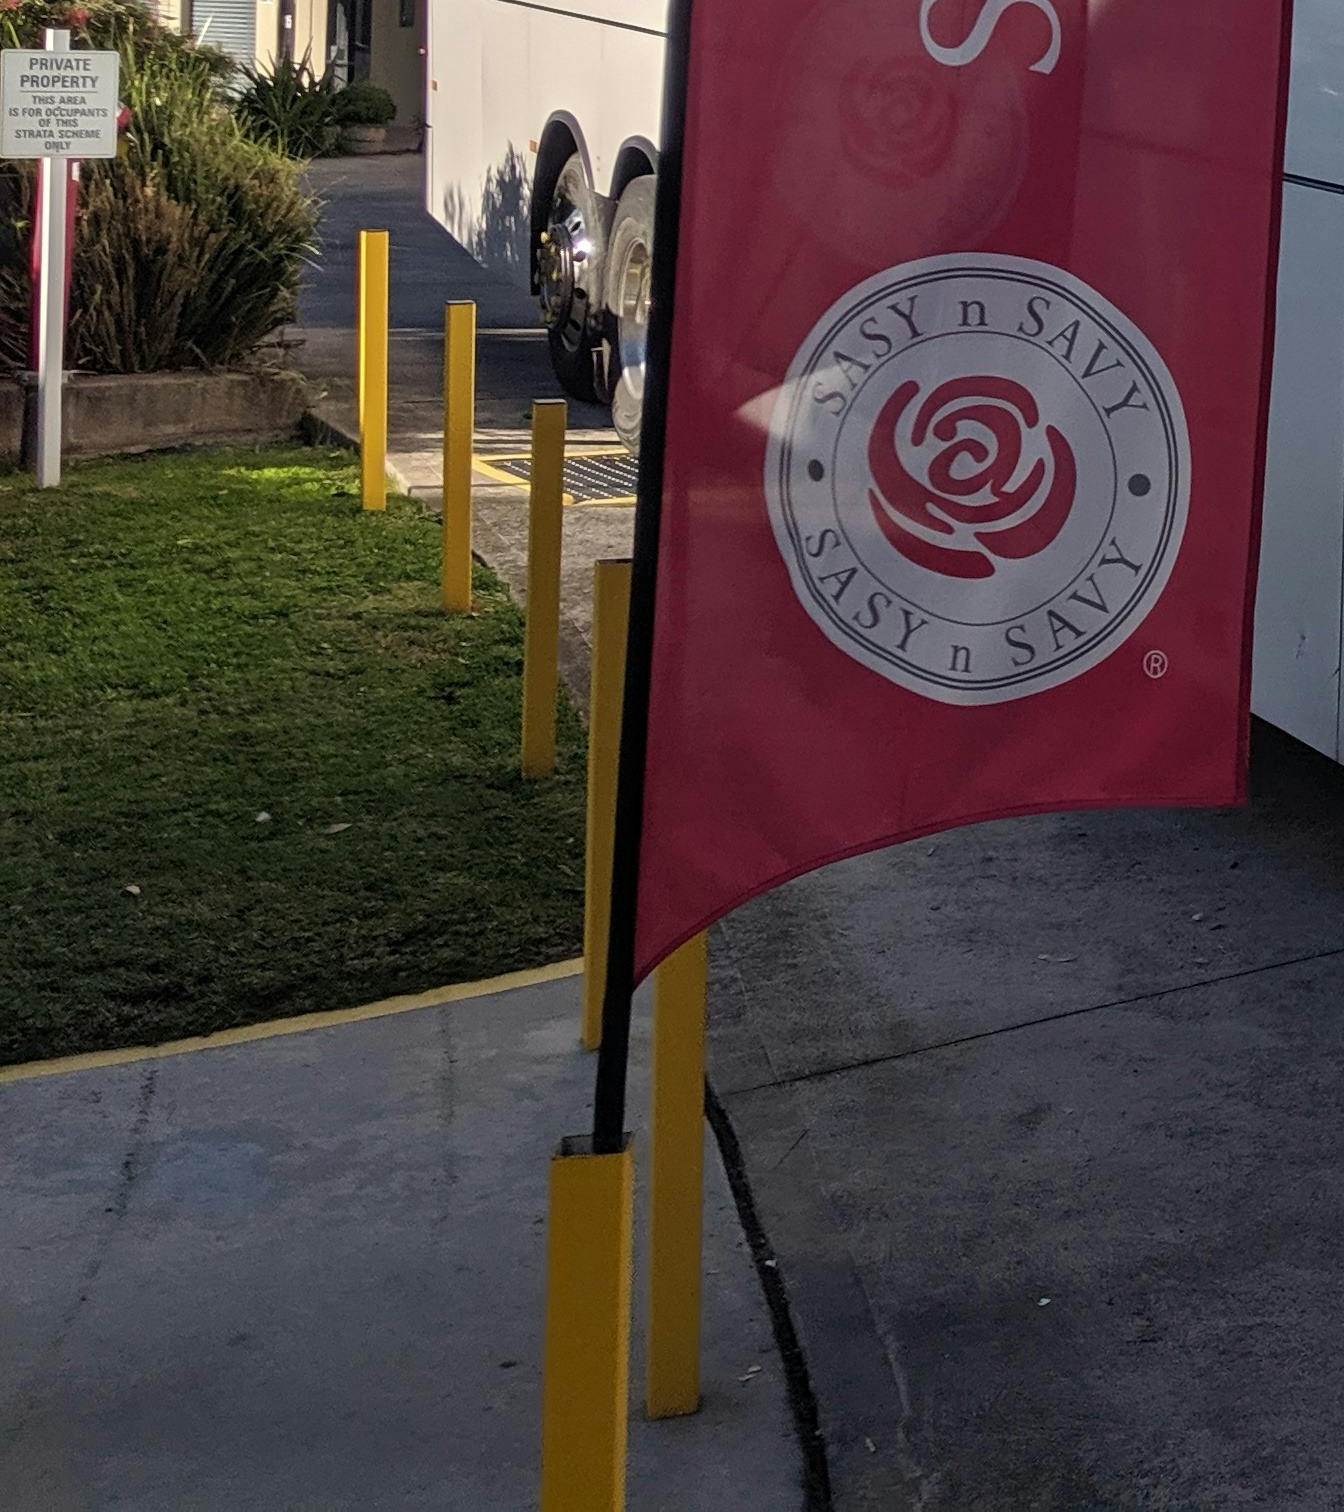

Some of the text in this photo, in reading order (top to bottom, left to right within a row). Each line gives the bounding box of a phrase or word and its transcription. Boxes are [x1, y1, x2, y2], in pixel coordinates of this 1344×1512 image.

[29, 57, 92, 71] PRIVATE
[20, 74, 99, 88] PROPERTY
[32, 95, 87, 105] THIS AREA
[9, 107, 108, 118] IS FOR OCCUPANTS
[39, 118, 79, 128] OF THIS
[15, 129, 101, 139] STRATA SCHEME
[44, 140, 71, 151] ONLY
[813, 294, 1150, 420] SASY n SAVY
[805, 528, 1143, 673] SASY n SAVY
